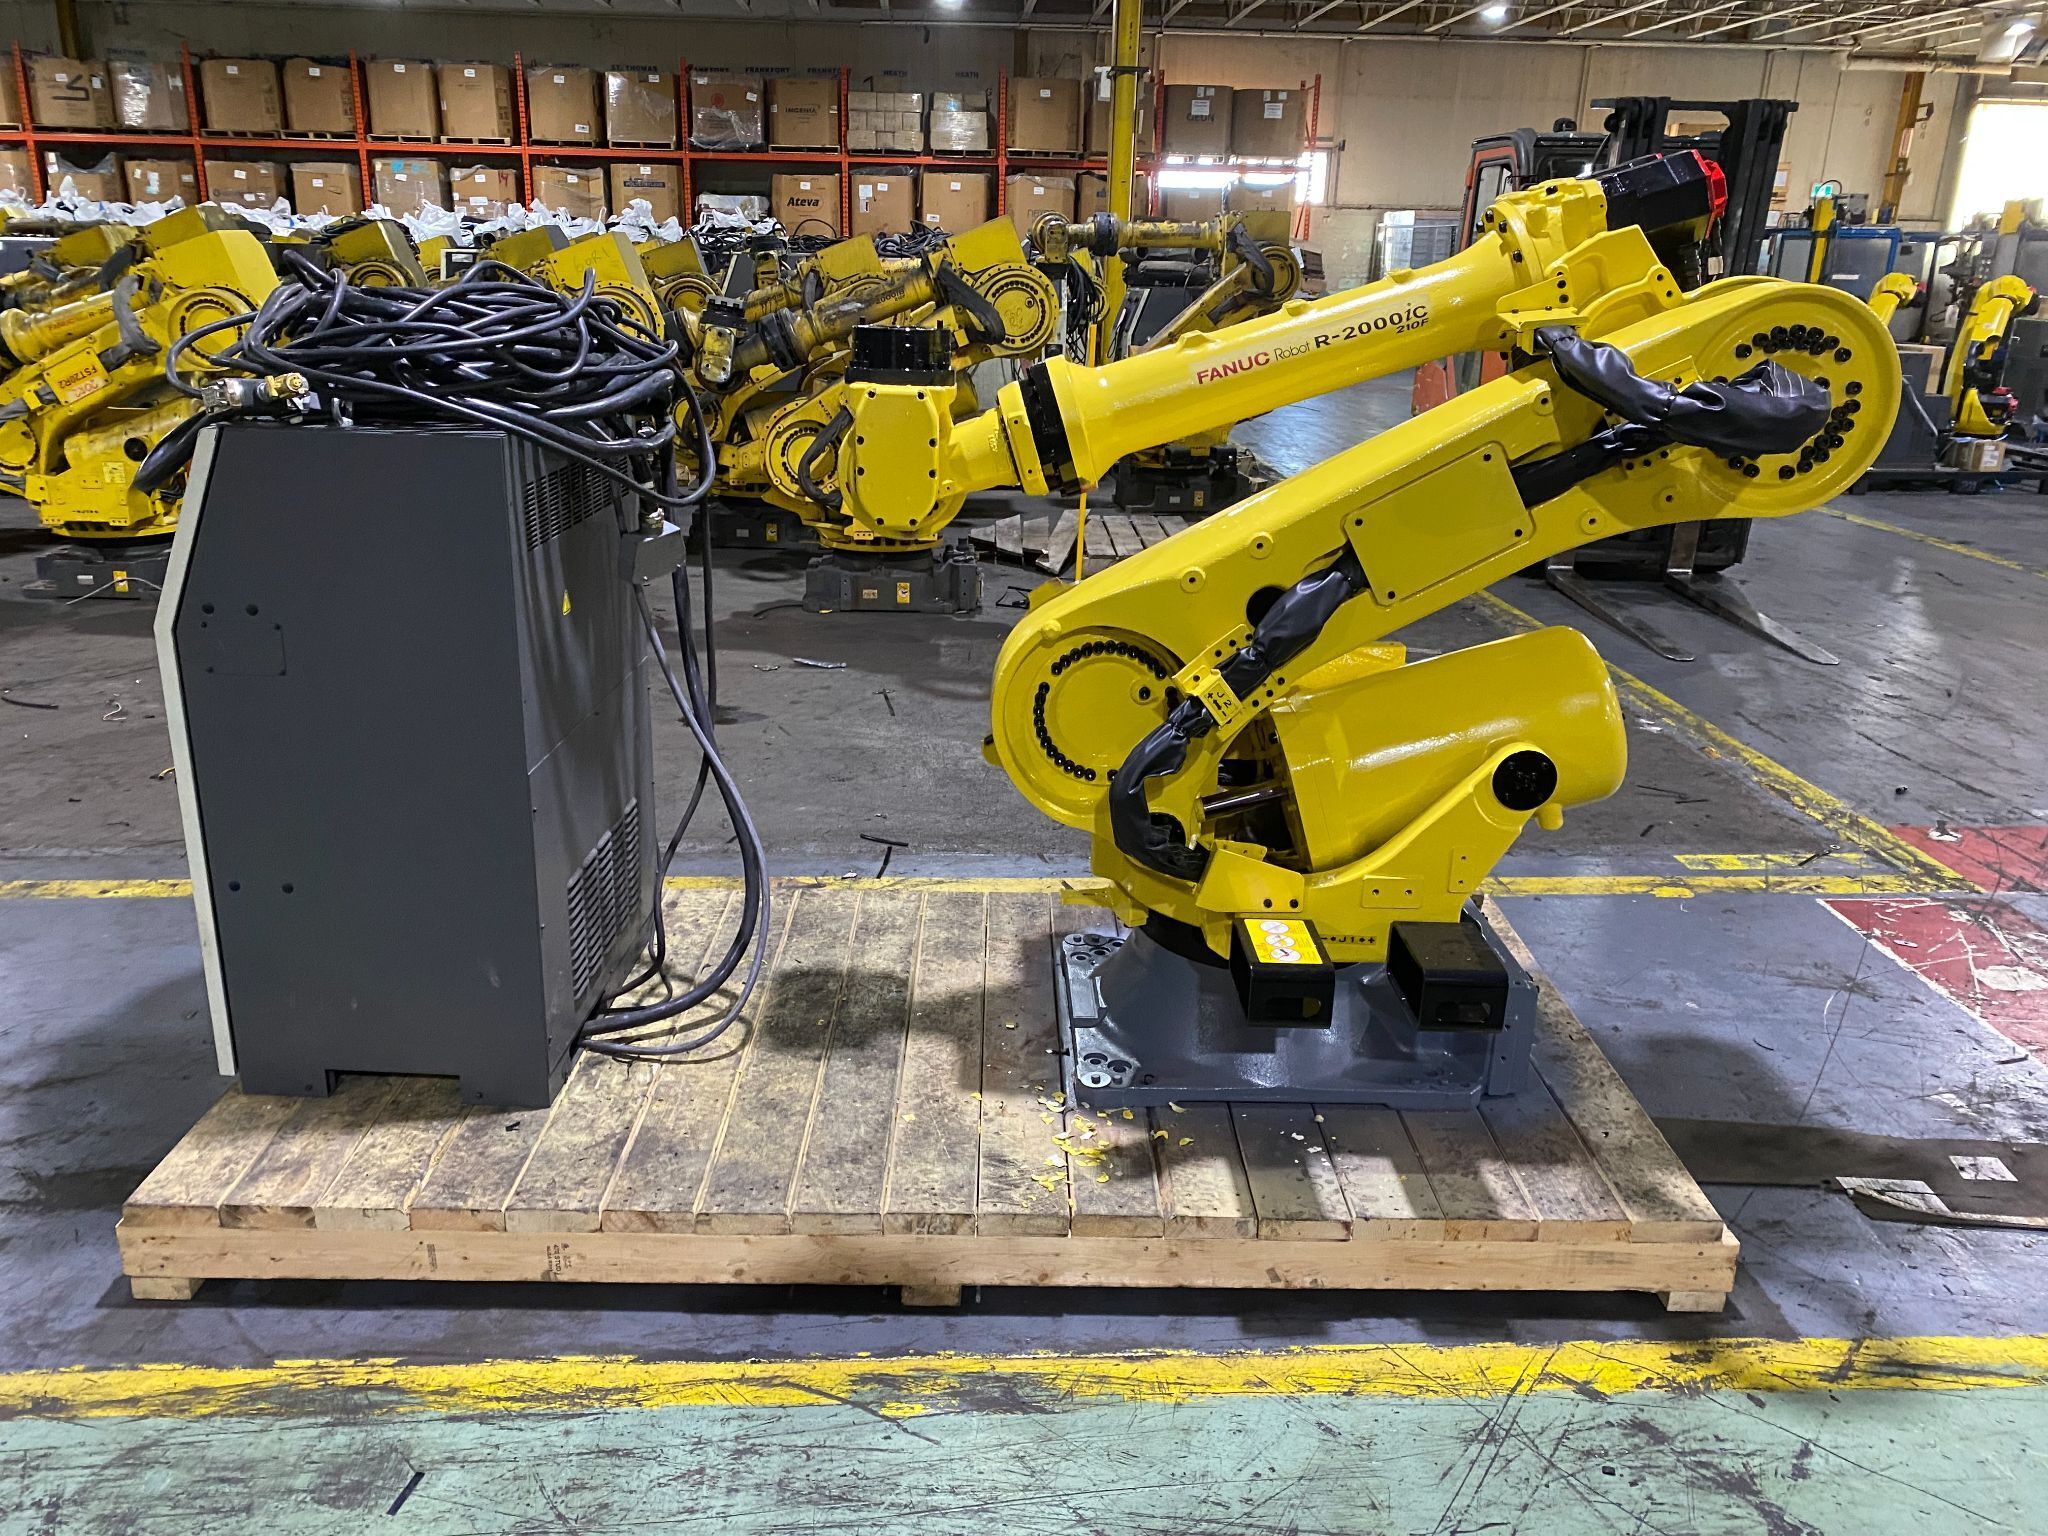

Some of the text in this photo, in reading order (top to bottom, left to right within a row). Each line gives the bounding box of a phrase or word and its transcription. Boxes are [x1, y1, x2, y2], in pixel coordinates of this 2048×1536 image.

[626, 64, 658, 72] THOMAS
[745, 66, 790, 74] FRANKFORT
[955, 71, 979, 79] HEATH
[787, 196, 820, 207] Ateva
[1395, 317, 1430, 334] 210F
[1196, 302, 1429, 384] FANUC Robot R-2000iC
[58, 365, 98, 389] FST20R2
